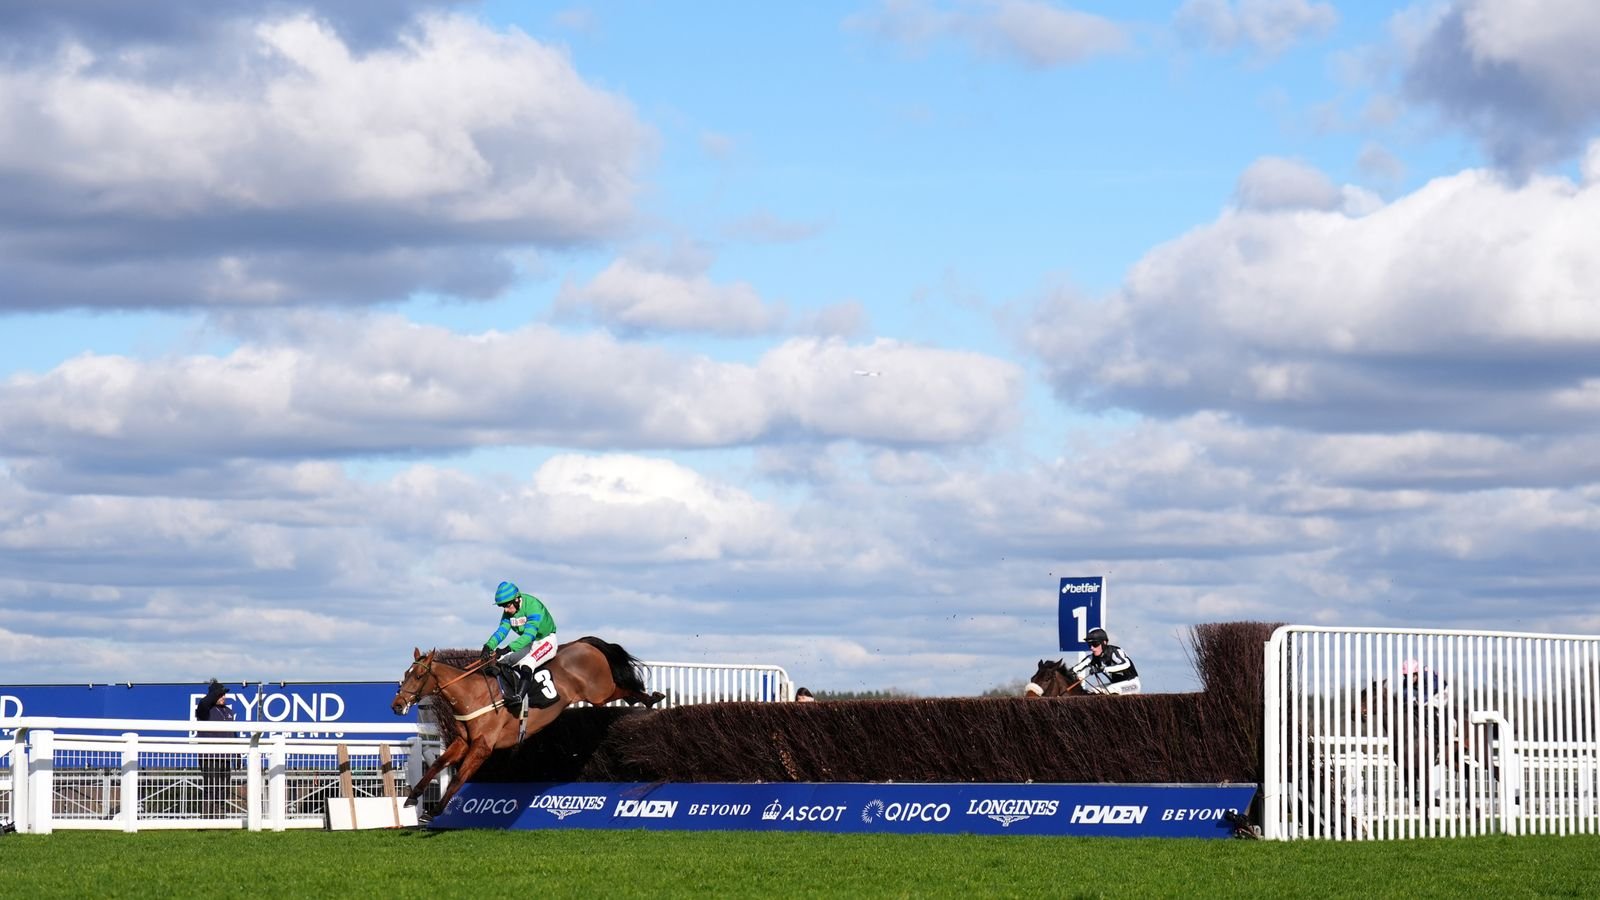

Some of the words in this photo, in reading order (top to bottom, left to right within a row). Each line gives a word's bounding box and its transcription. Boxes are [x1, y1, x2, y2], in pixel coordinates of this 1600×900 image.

[1070, 583, 1100, 593] betfair
[1072, 606, 1087, 642] 1
[534, 669, 557, 699] 3
[463, 798, 517, 814] QIPCO
[529, 795, 607, 810] LONGINES
[614, 800, 678, 817] HOWDEN
[688, 804, 751, 815] BEYOND
[967, 799, 1059, 815] LONGINES
[781, 806, 847, 821] ASCOT
[885, 803, 950, 822] QIPCO
[1070, 805, 1148, 824] HOWDEN
